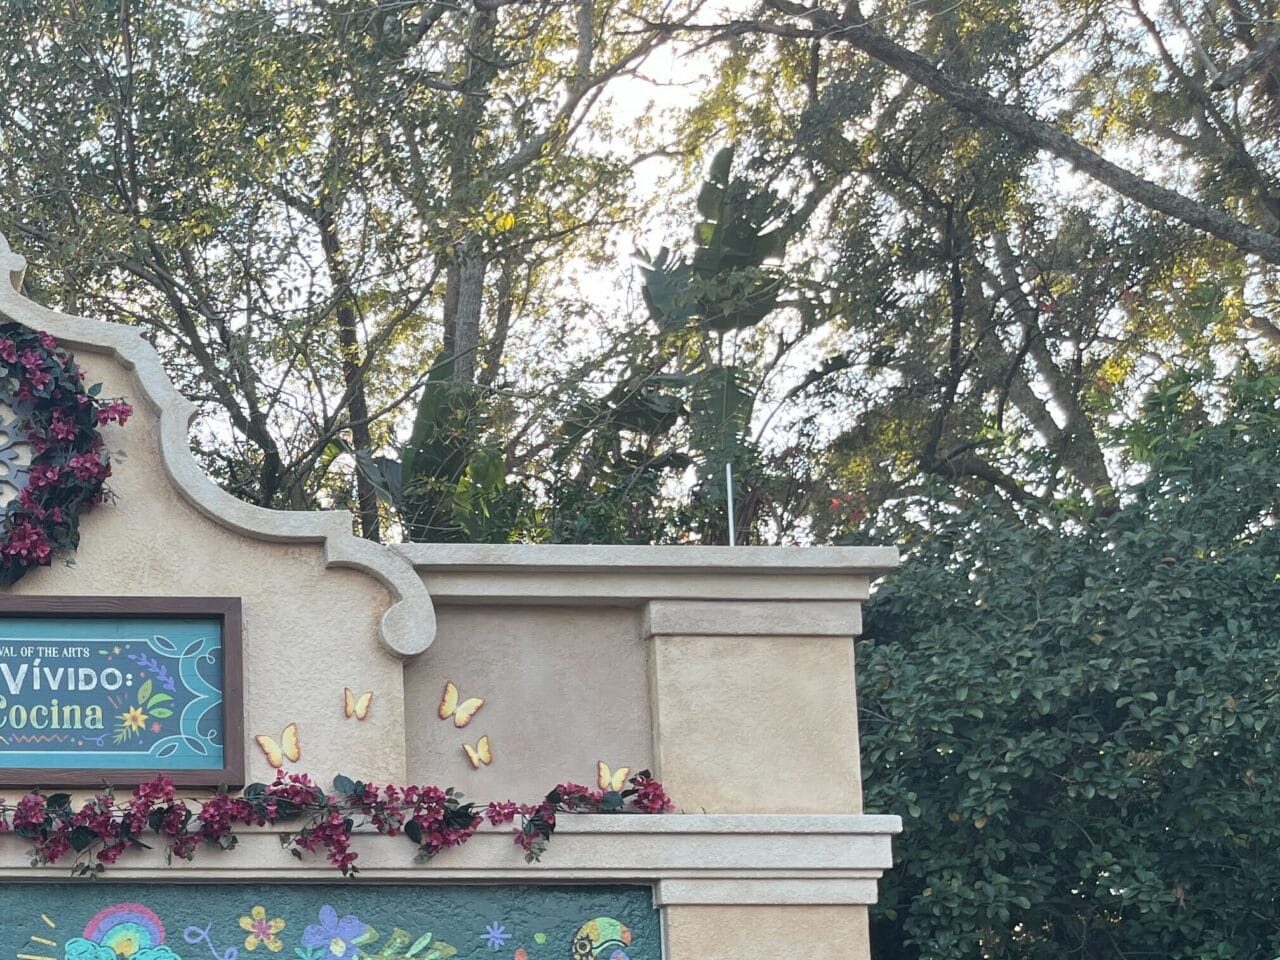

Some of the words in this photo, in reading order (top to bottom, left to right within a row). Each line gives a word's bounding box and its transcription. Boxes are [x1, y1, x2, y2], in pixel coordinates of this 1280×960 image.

[20, 646, 35, 657] OF
[37, 646, 59, 658] THE
[61, 647, 90, 658] ARTS
[0, 658, 133, 695] VÍVIDO:
